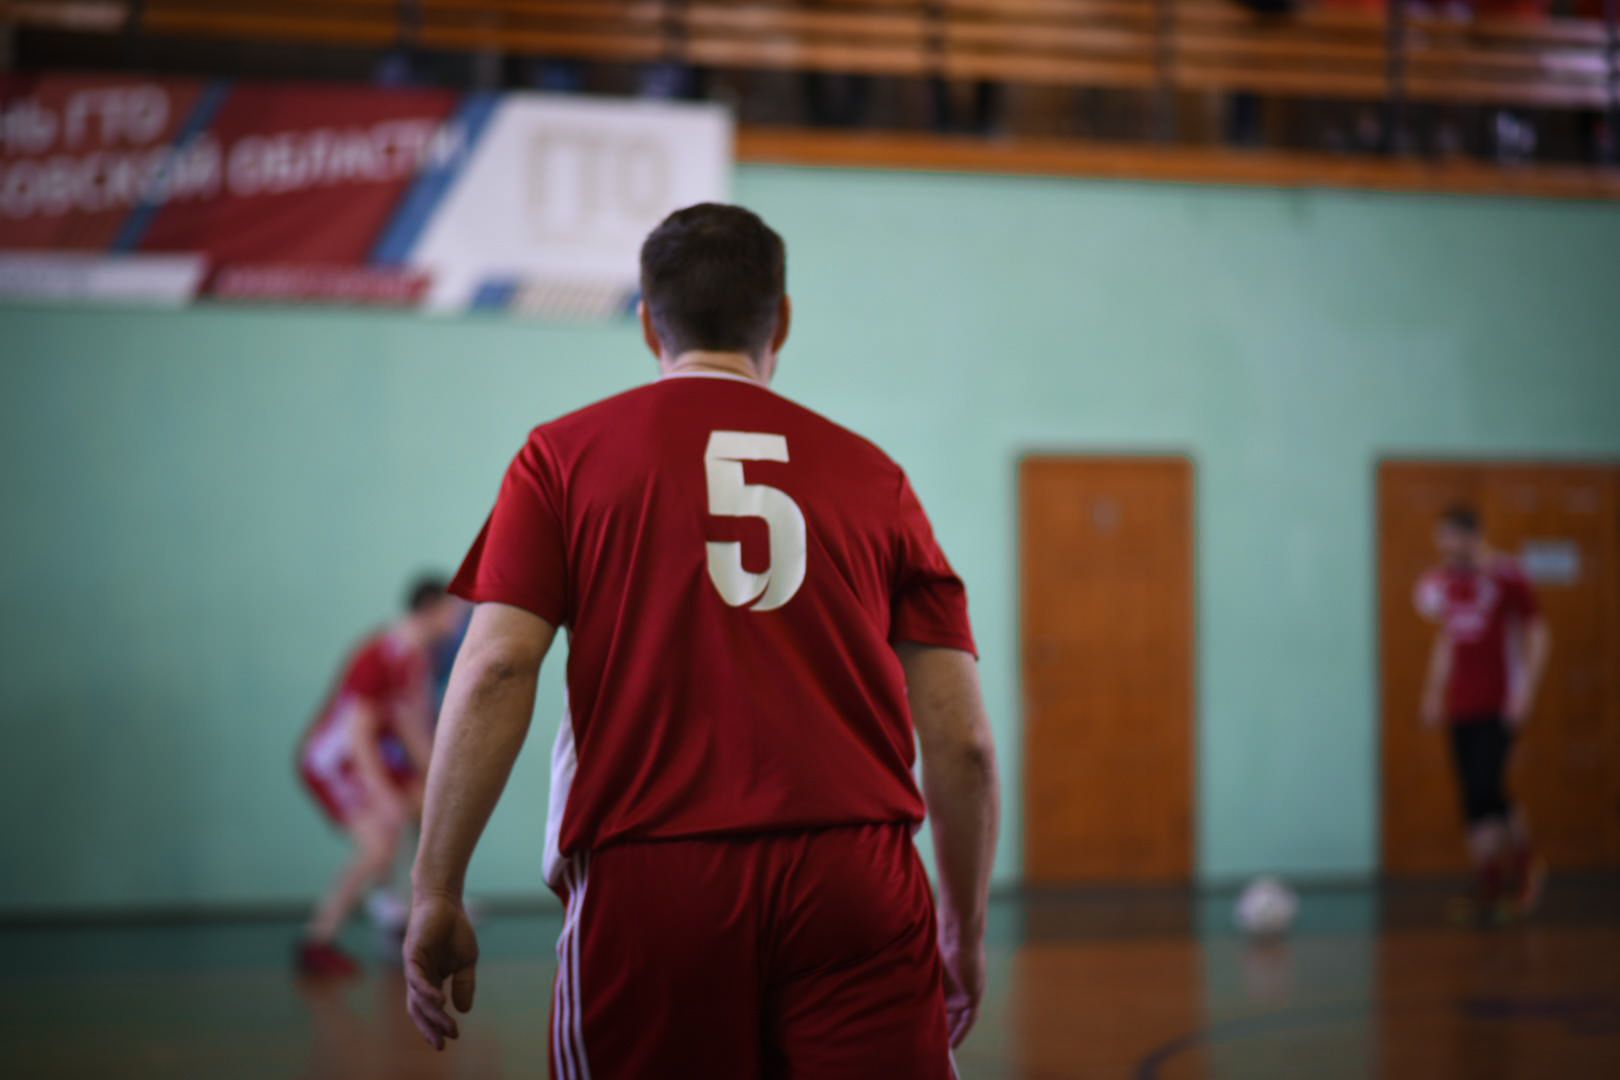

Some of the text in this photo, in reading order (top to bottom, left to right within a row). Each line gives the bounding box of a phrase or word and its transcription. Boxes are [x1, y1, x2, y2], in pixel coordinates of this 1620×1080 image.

[65, 84, 170, 149] ГТО
[0, 118, 465, 219] ОВСКОЙ ОБЛАСТИ
[704, 430, 807, 611] 5
